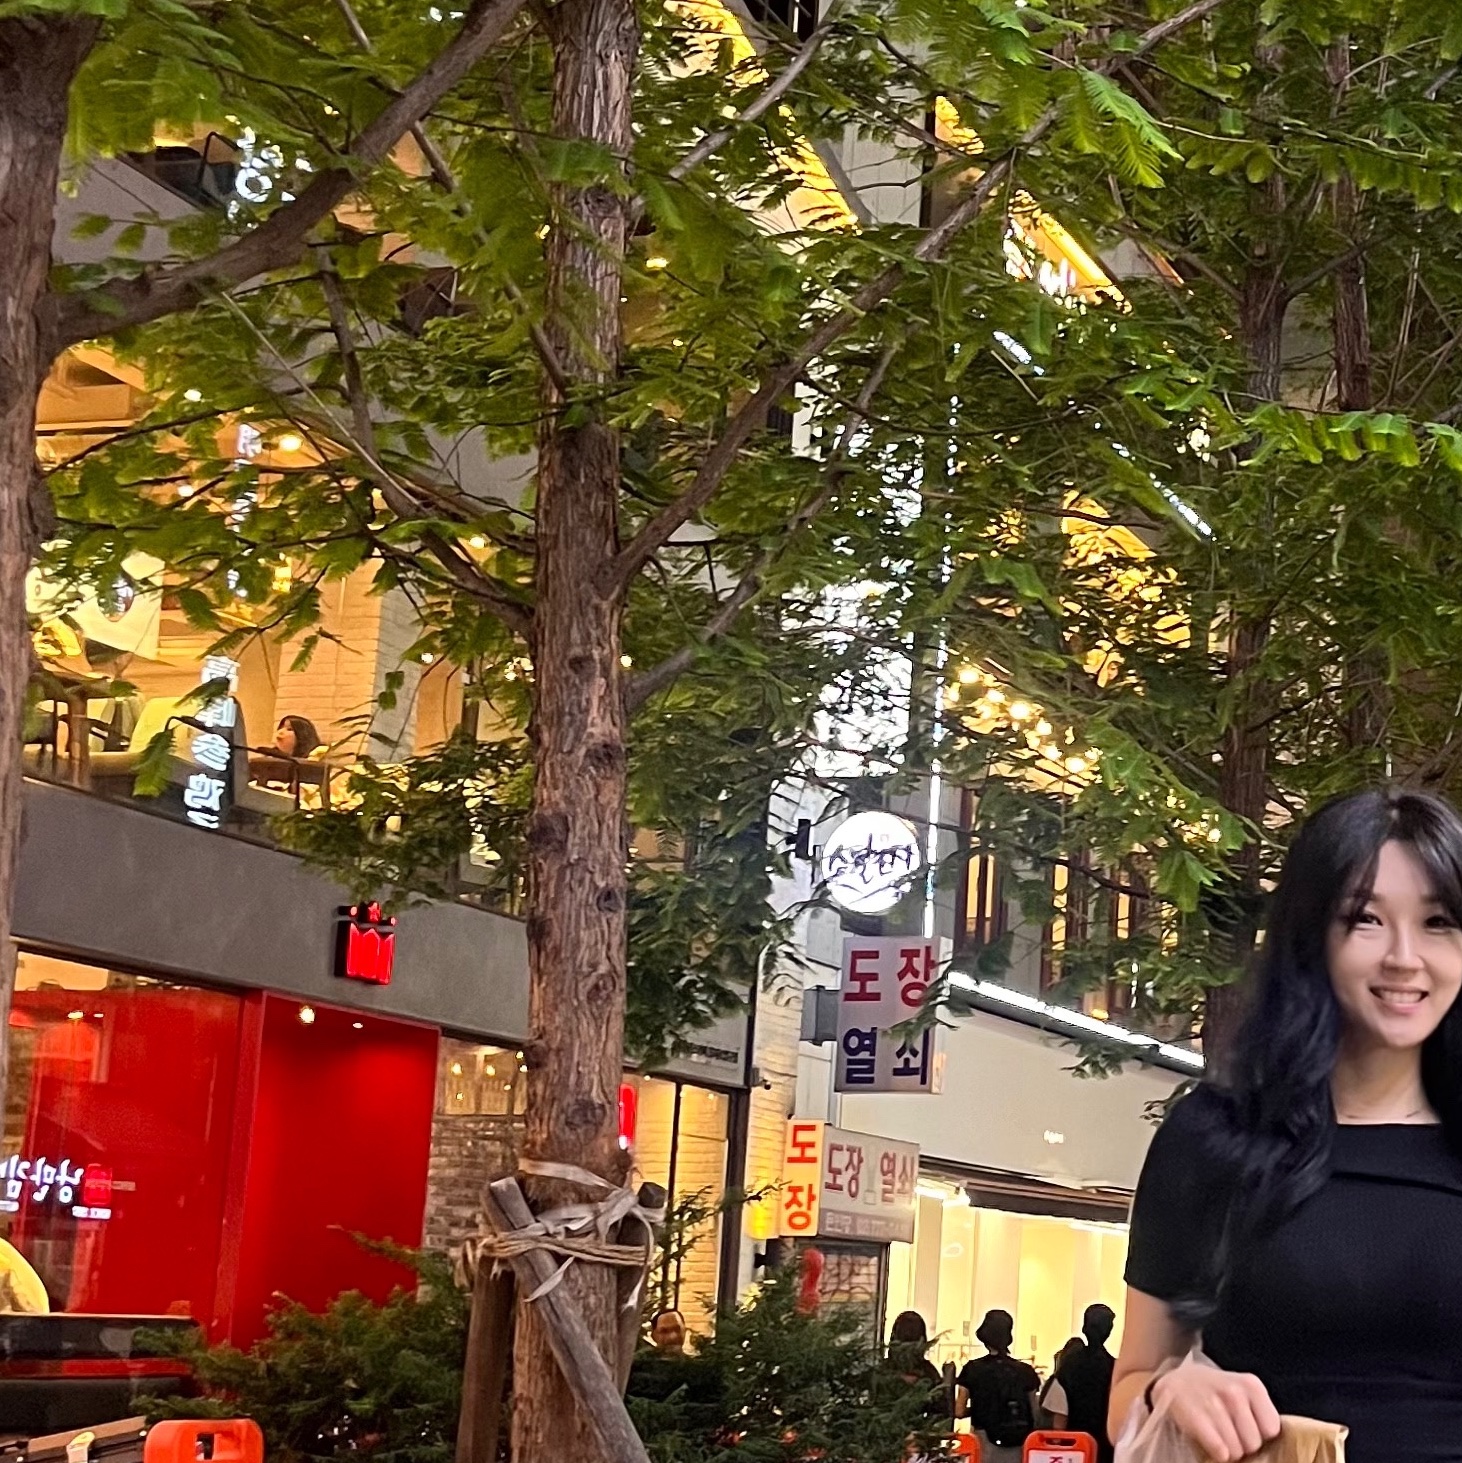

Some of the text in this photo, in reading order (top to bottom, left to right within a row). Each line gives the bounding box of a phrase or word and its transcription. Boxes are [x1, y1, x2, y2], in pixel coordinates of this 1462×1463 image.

[842, 945, 937, 1008] 도장
[842, 1026, 931, 1086] 열쇠
[784, 1124, 818, 1230] 도장
[824, 1143, 916, 1205] 도장 열쇠
